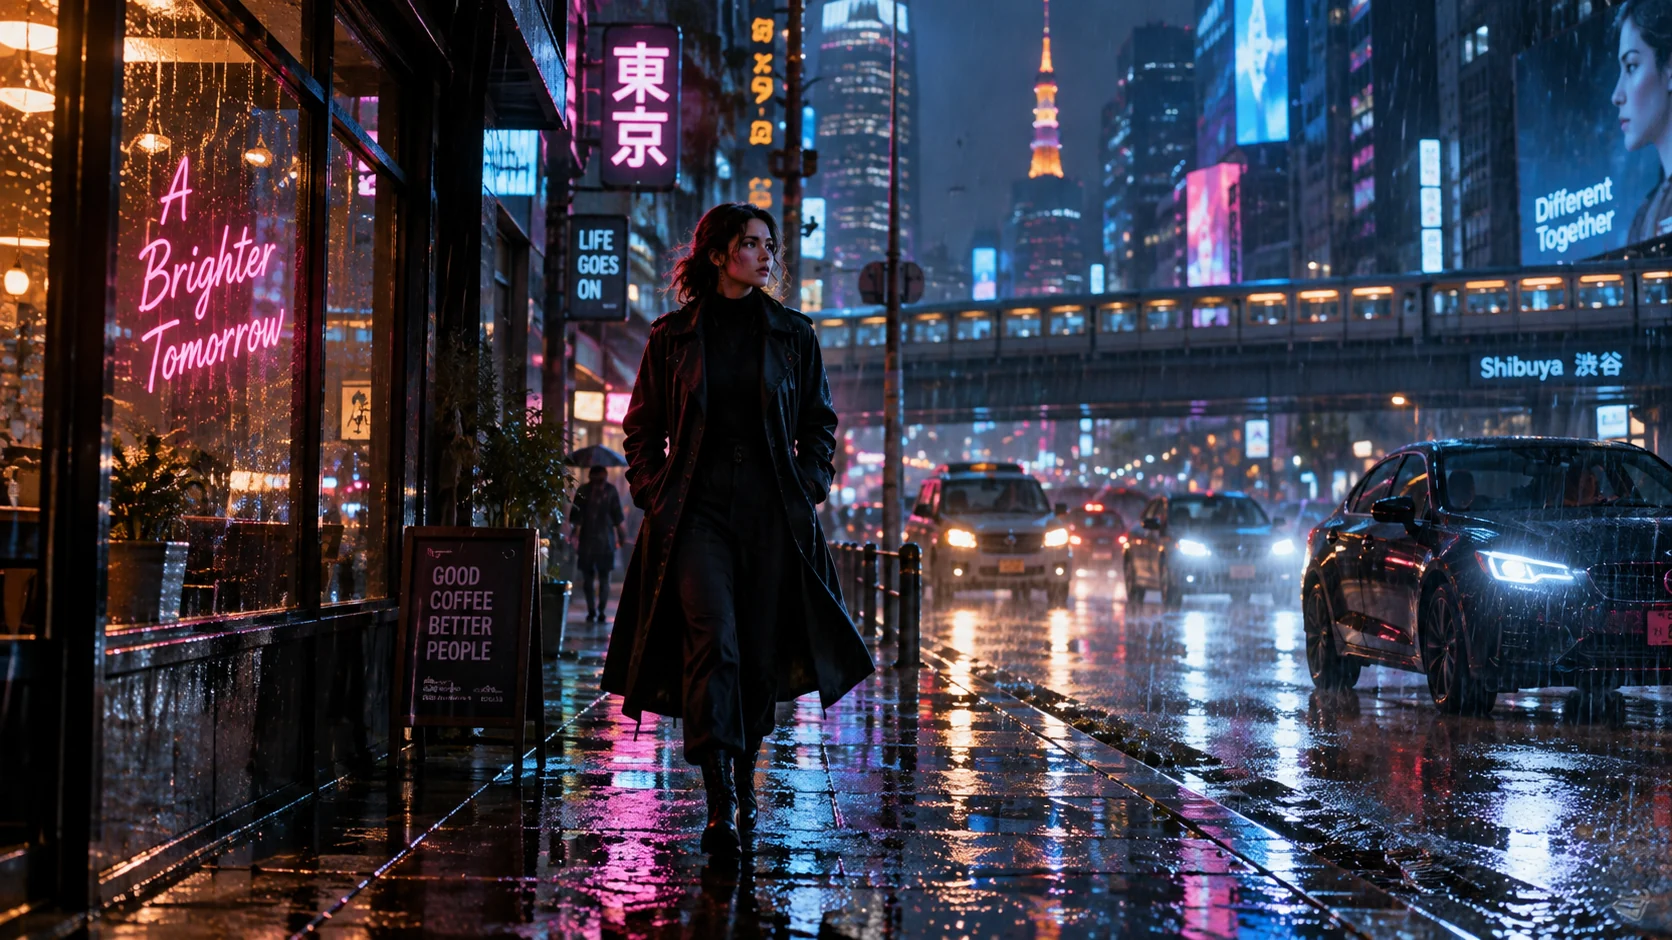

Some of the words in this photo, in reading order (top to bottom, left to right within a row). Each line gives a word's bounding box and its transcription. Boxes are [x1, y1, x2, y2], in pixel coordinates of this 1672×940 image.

[611, 41, 670, 168] 東京
[160, 156, 192, 225] A
[1535, 176, 1613, 223] Different
[579, 229, 614, 251] LIFE
[1535, 209, 1615, 253] Together
[139, 224, 276, 320] Brighter
[577, 254, 620, 275] GOES
[577, 278, 602, 300] ON
[141, 308, 284, 393] Tomorrow
[1480, 355, 1564, 381] Shibuya
[1574, 351, 1623, 377] 渋谷
[432, 566, 480, 586] GOOD
[430, 590, 494, 610] COFFEE
[428, 616, 492, 636] BETTER
[426, 641, 492, 661] PEOPLE
